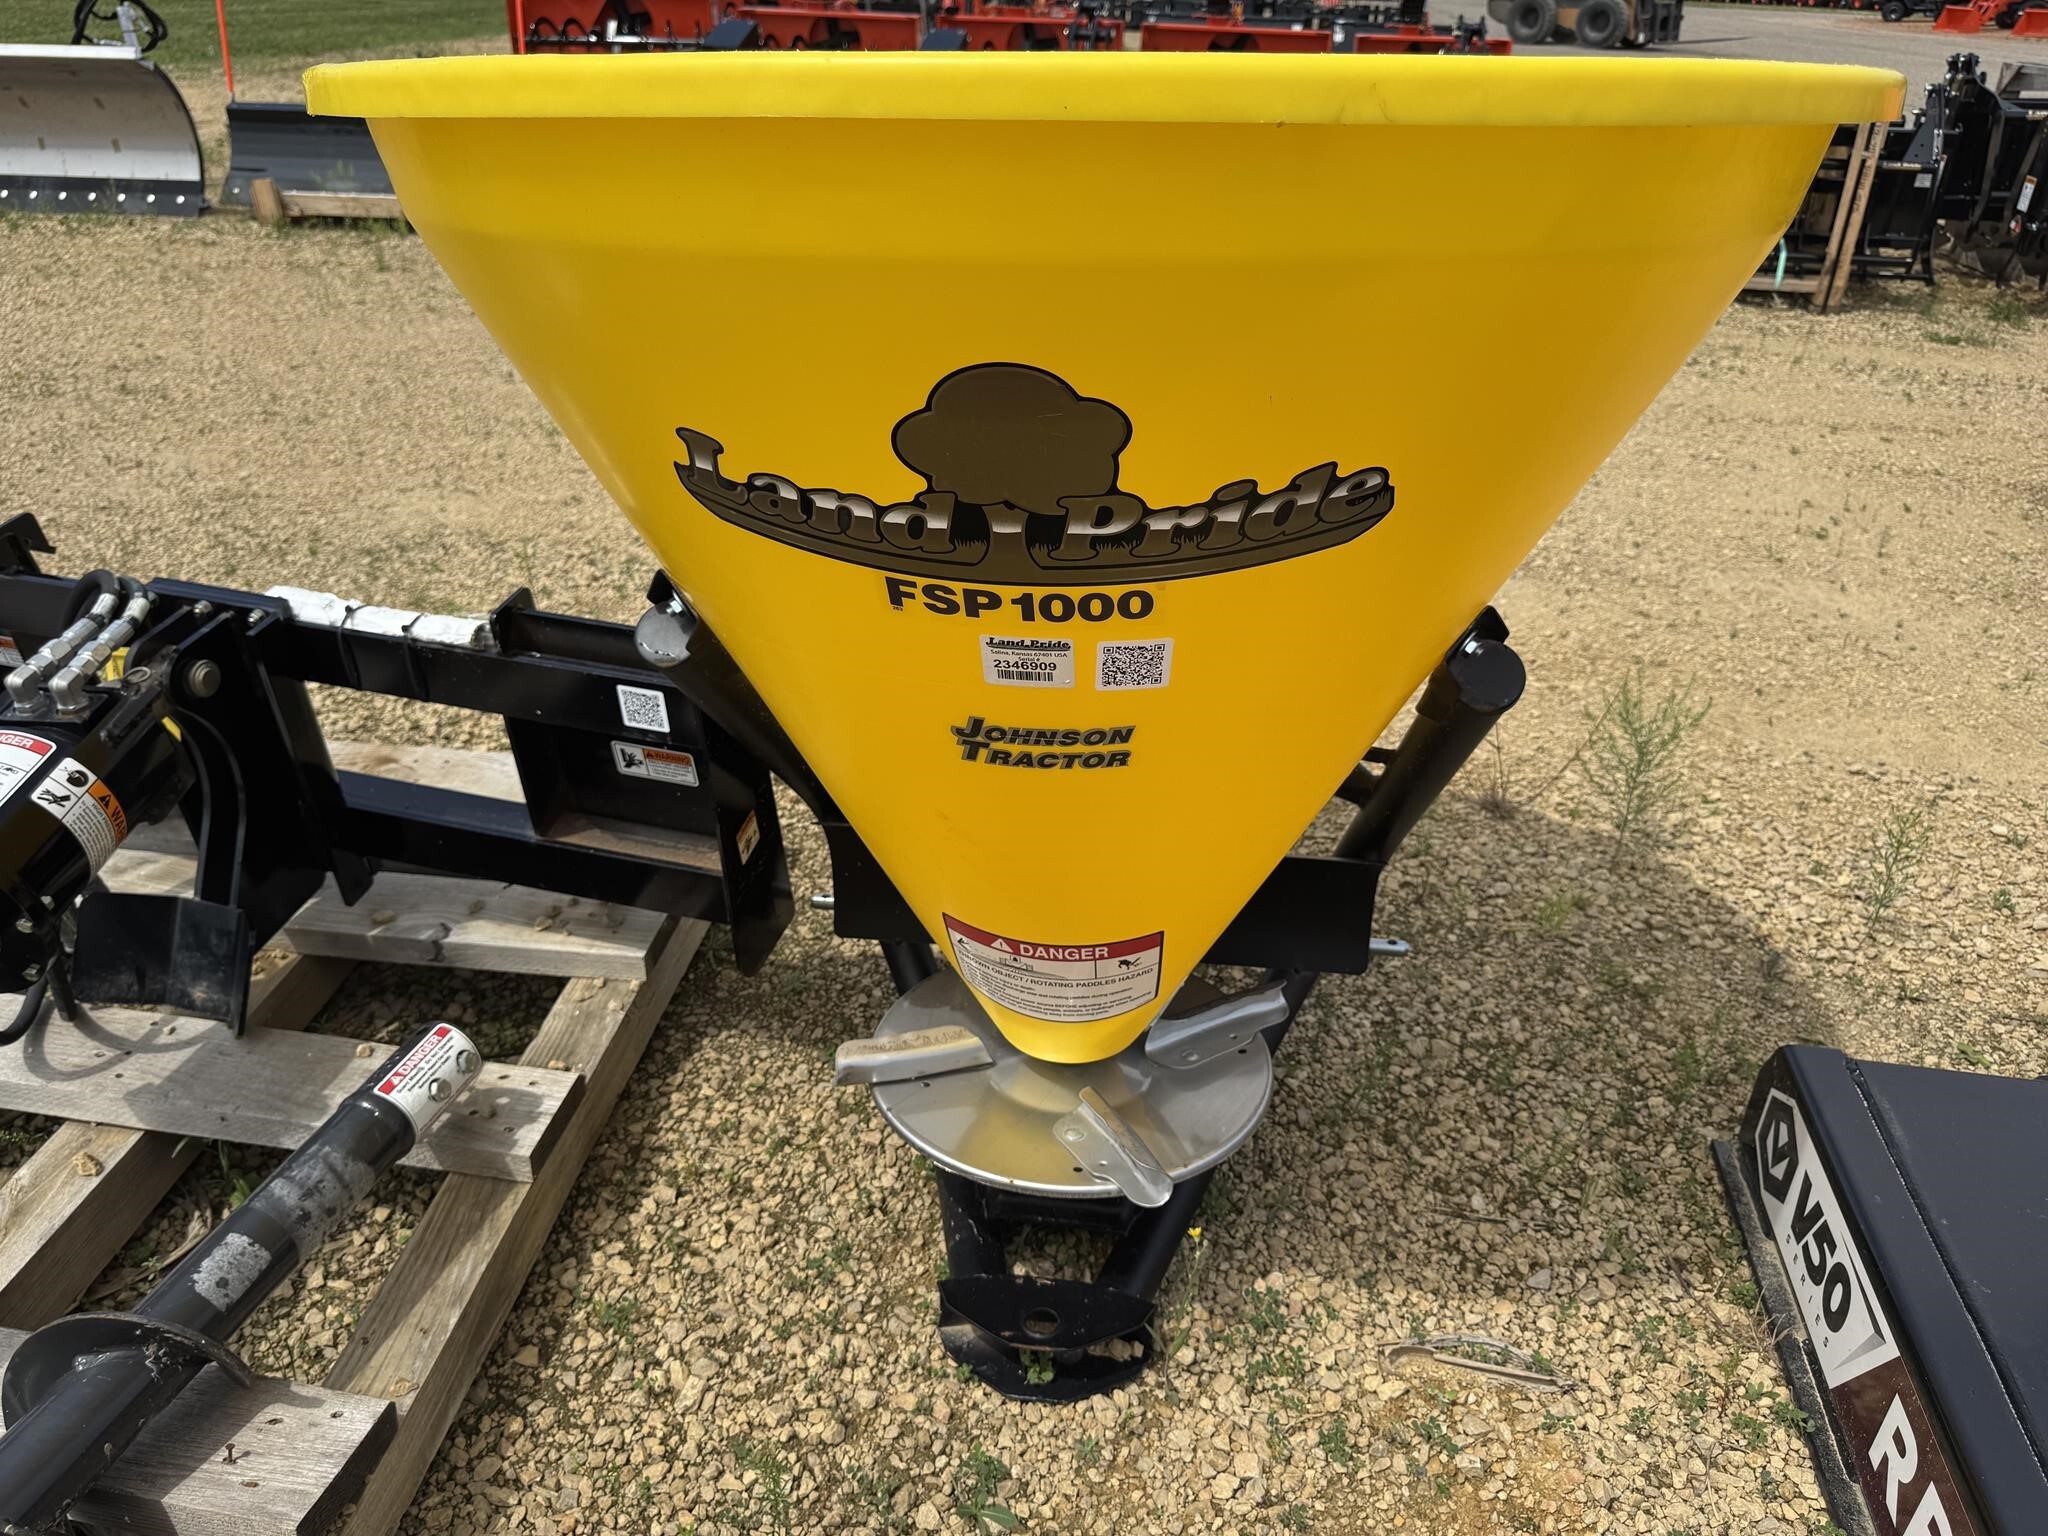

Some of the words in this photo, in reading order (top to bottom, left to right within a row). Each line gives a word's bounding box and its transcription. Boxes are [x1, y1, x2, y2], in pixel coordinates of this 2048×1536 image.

[675, 427, 958, 554] Land
[1047, 461, 1390, 561] Pride
[986, 637, 1027, 648] Land
[1029, 640, 1071, 650] Pride
[993, 659, 1057, 671] 2346909
[951, 716, 1136, 747] JOHNSON
[956, 738, 1132, 769] TRACTOR
[1019, 943, 1109, 961] DANGER
[991, 966, 1024, 982] OBJECT
[1030, 979, 1074, 988] ROTATING
[1076, 979, 1116, 987] PADDLES
[1118, 968, 1153, 982] HAZARD
[401, 1034, 443, 1076] DANGER
[1791, 1169, 1852, 1333] V50
[1786, 1233, 1829, 1348] SERIES
